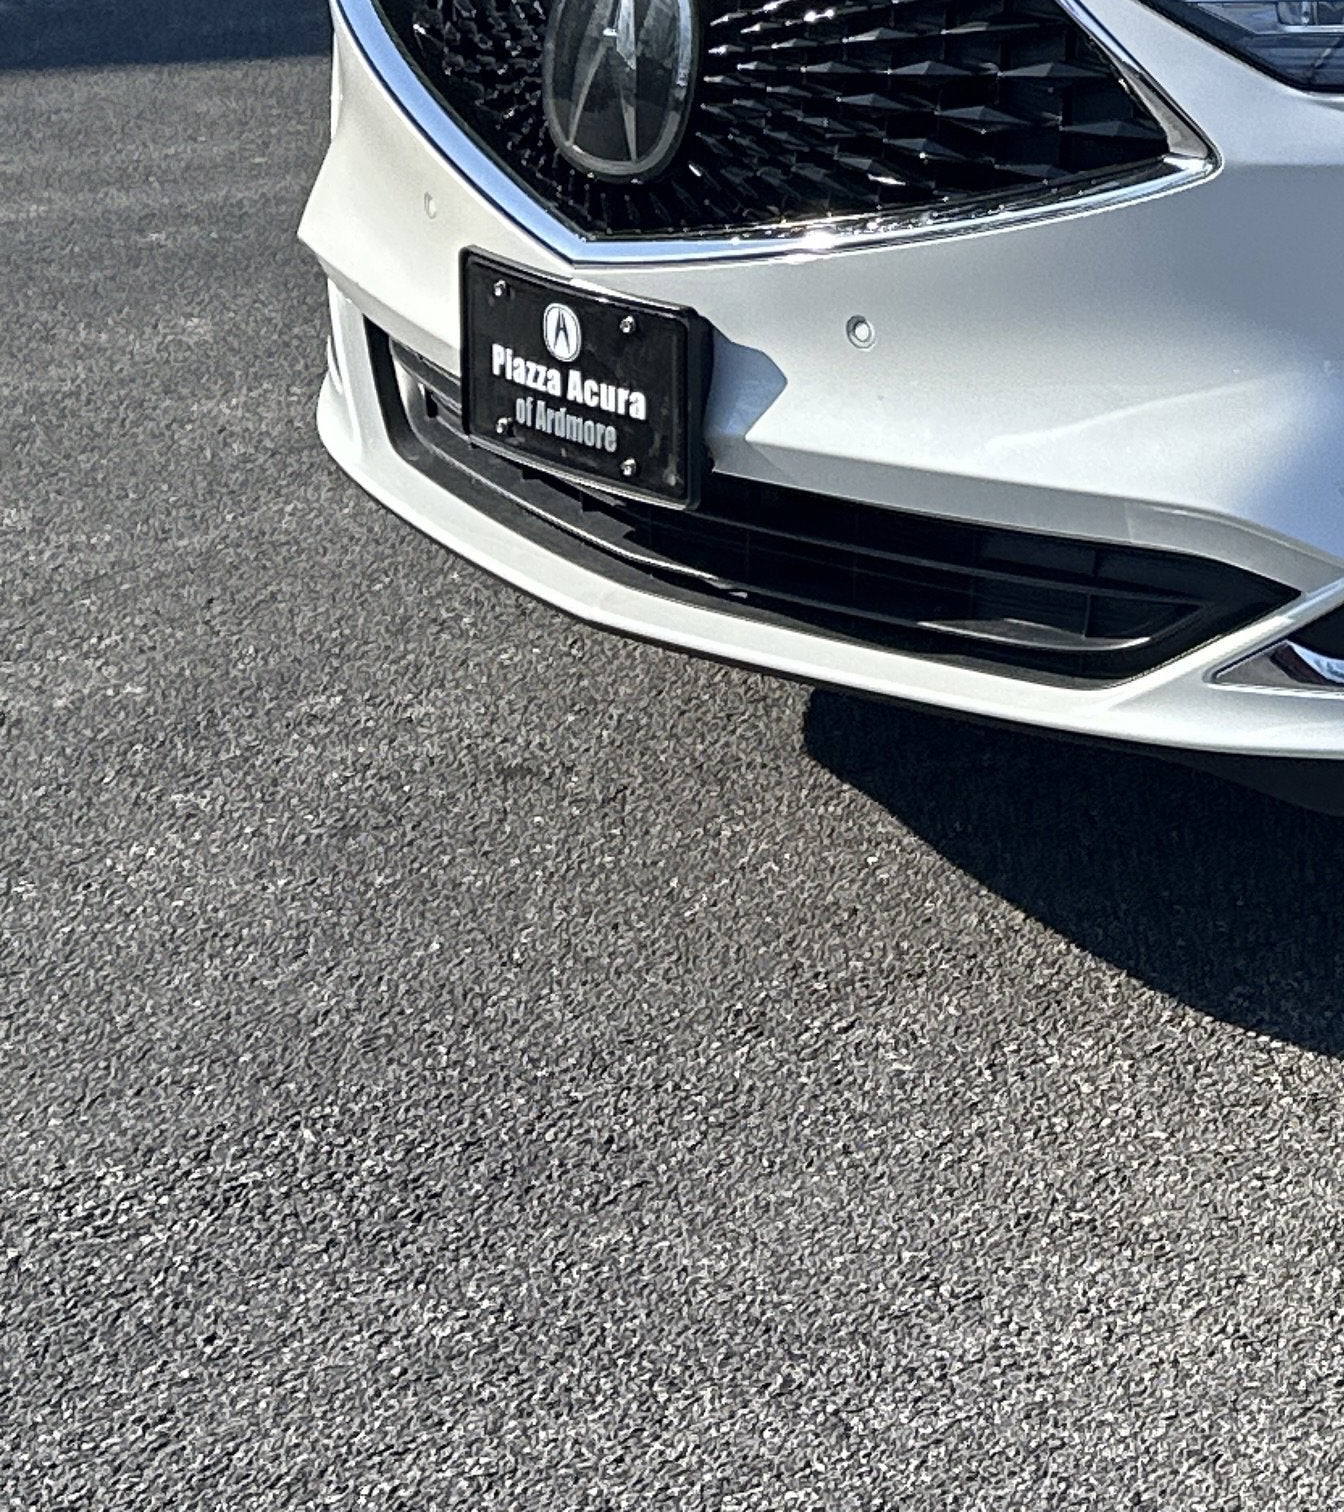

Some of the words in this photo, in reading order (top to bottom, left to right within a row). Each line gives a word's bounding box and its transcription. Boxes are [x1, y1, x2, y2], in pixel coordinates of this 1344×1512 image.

[491, 343, 562, 397] Piazza
[566, 369, 647, 420] Acura
[515, 396, 534, 426] of
[535, 400, 617, 453] Ardmore
